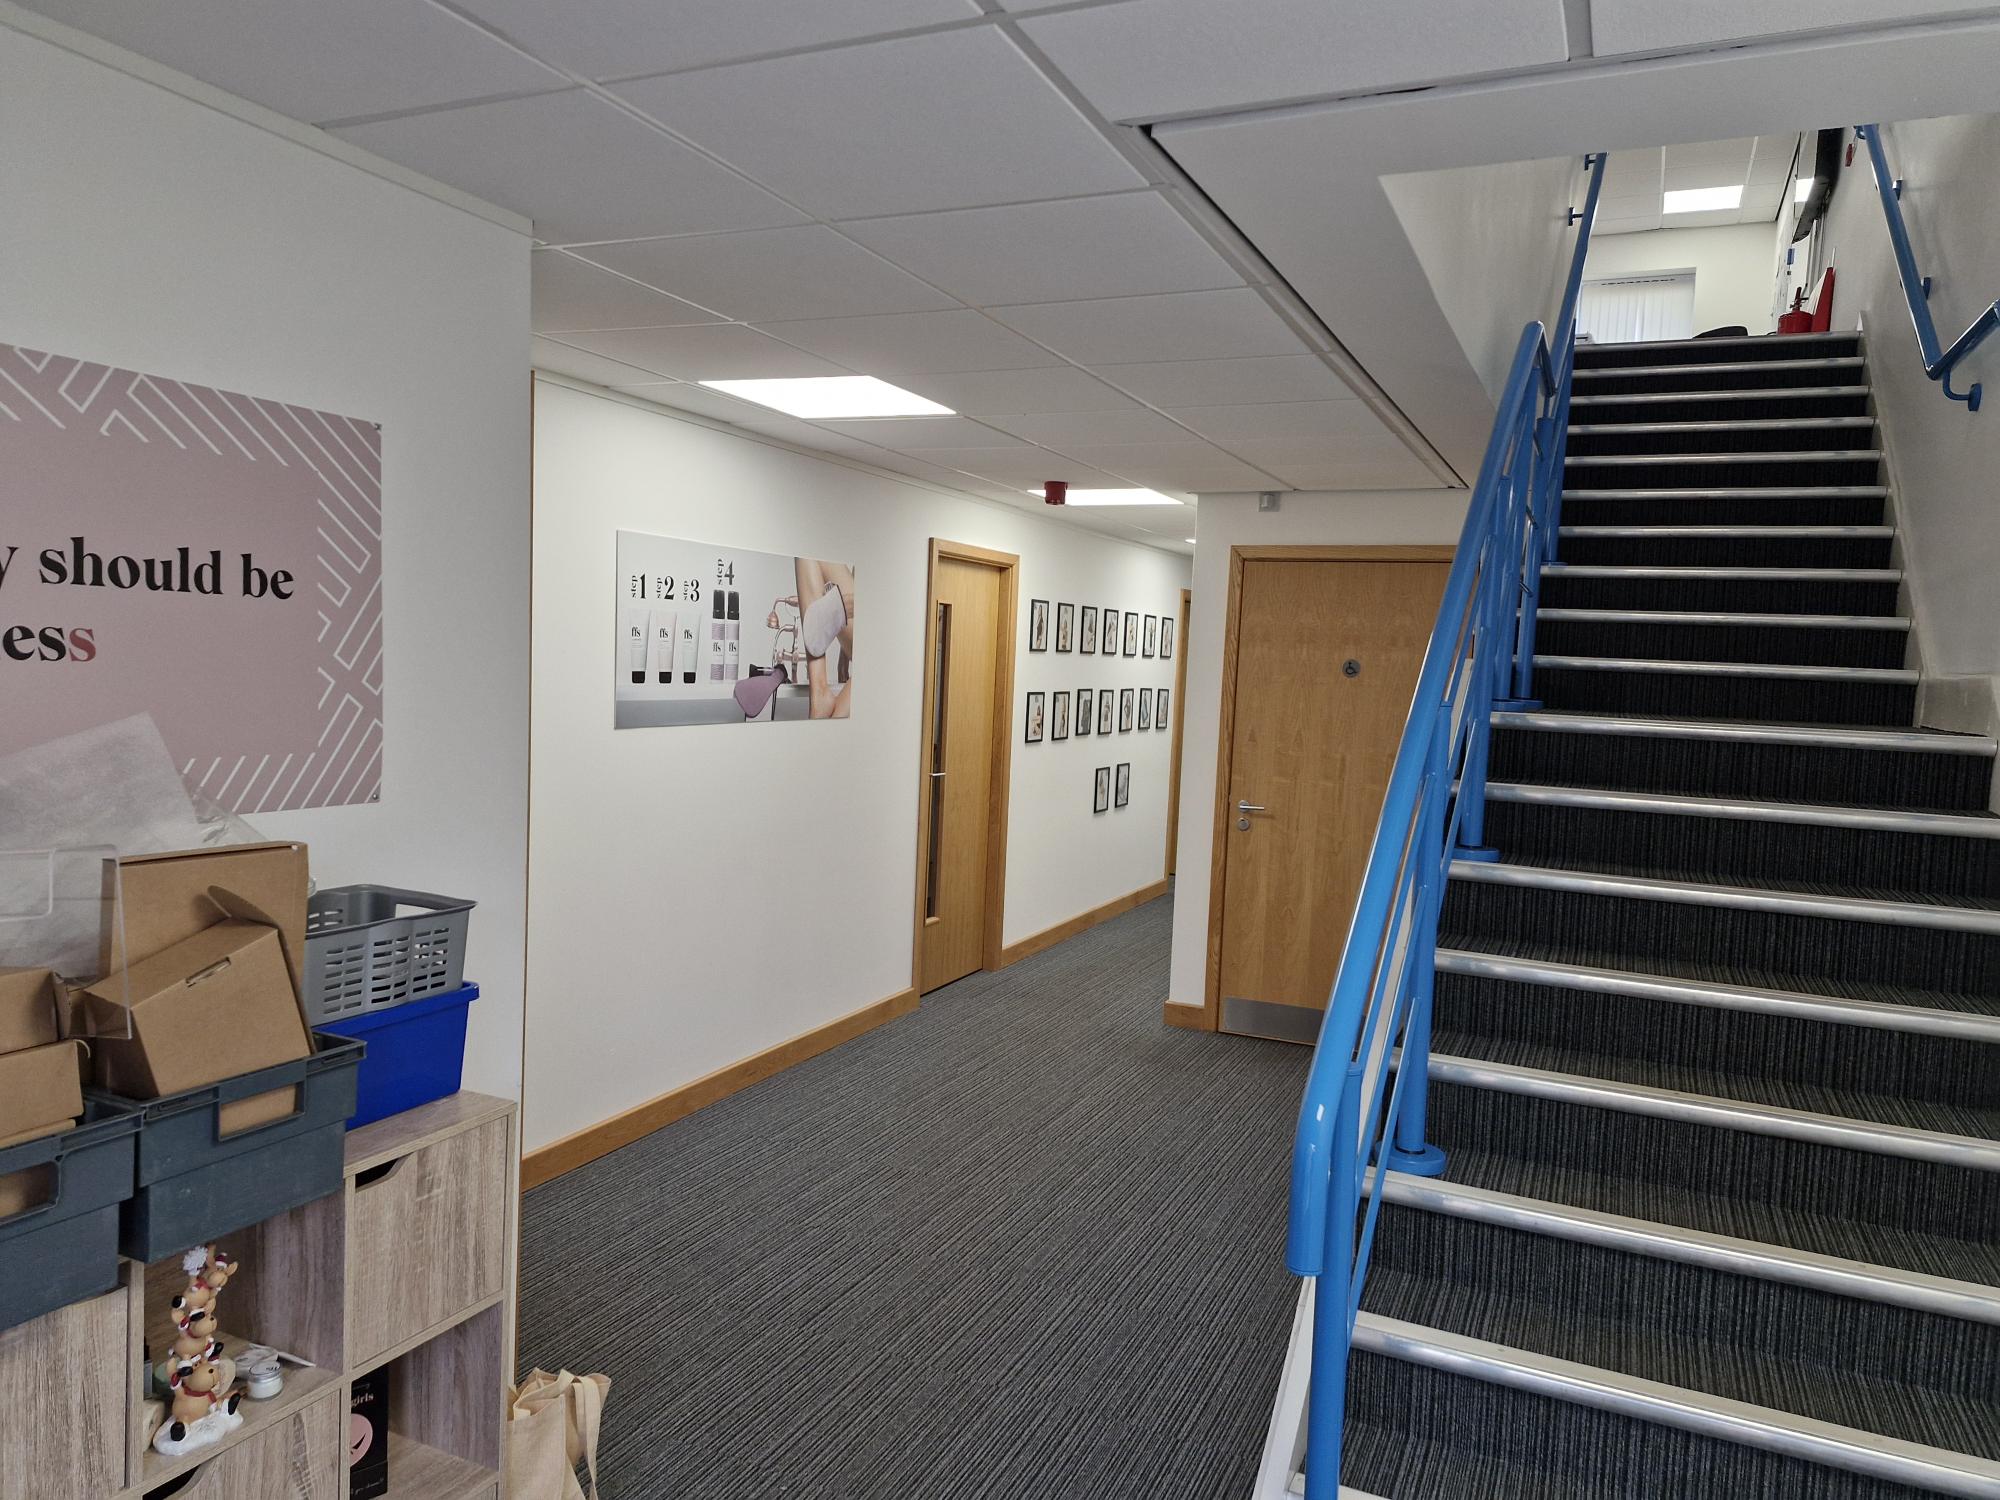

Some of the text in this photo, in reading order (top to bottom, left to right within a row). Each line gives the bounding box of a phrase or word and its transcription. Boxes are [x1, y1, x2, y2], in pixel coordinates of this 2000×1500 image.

[39, 536, 224, 595] should
[240, 553, 294, 600] be
[724, 560, 735, 586] 4
[640, 573, 646, 599] 1
[664, 575, 675, 600] 2
[690, 578, 700, 602] 3
[631, 626, 640, 637] ffs
[659, 627, 669, 638] ffs
